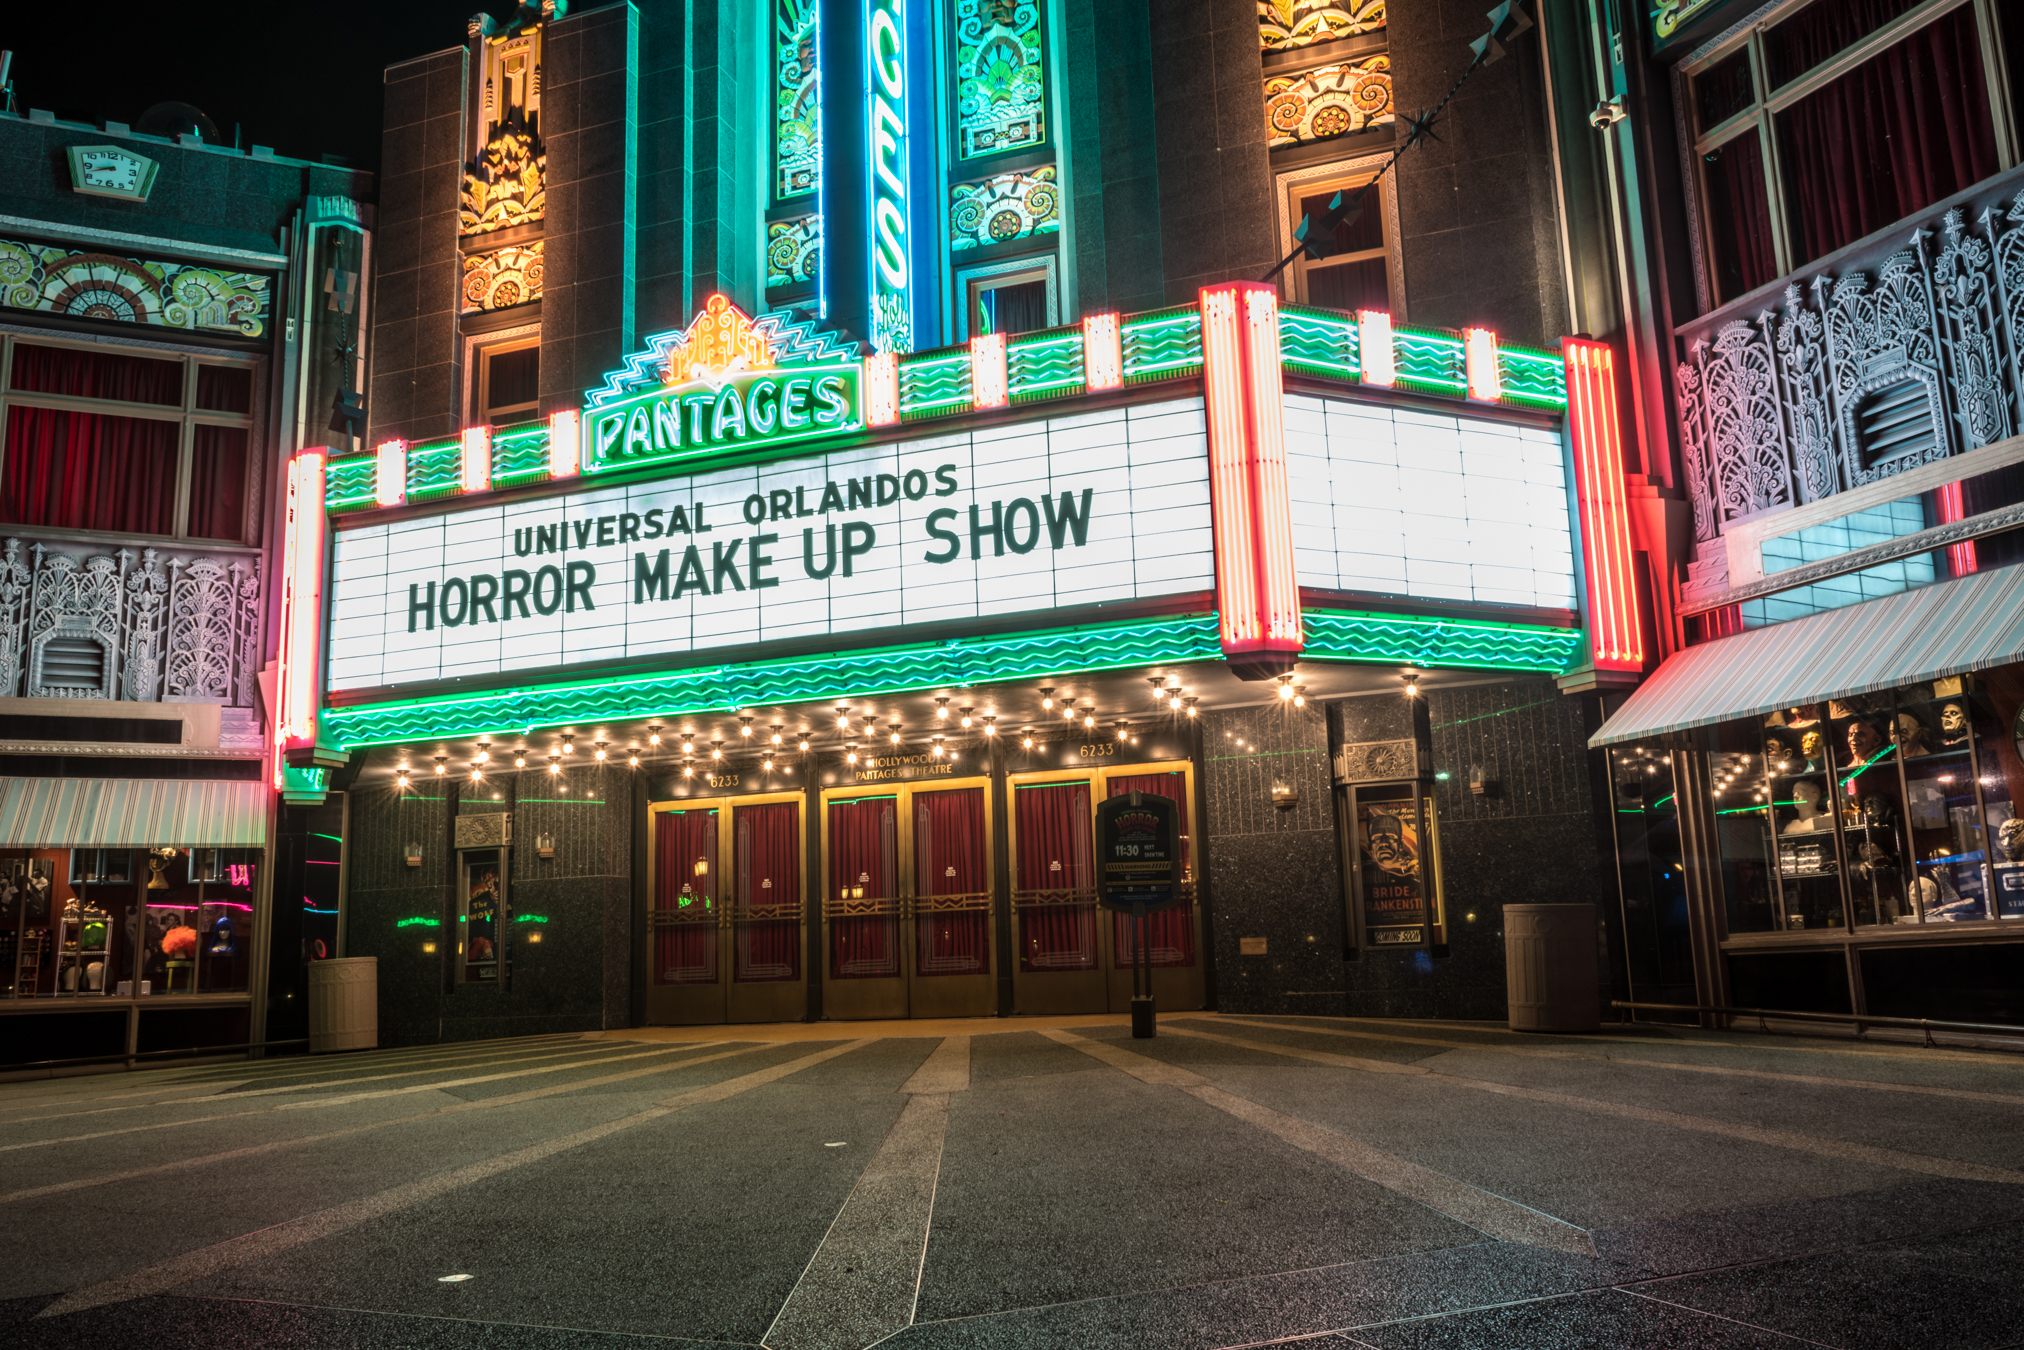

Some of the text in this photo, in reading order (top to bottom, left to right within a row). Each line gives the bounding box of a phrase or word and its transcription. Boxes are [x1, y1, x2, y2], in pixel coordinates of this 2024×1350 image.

[107, 152, 118, 160] 12
[595, 376, 848, 462] PANTAGES
[514, 464, 958, 557] UNIVERSAL ORLANDOS
[408, 488, 1093, 633] HORROR MAKE UP SHOW
[1080, 743, 1114, 758] 6233
[871, 754, 935, 768] HOLLYWOOD
[855, 763, 953, 780] PANTAGES THEATRE
[710, 774, 739, 788] 6233
[1114, 812, 1160, 830] HORROR
[1115, 844, 1139, 857] 11:30
[1373, 886, 1410, 898] BRIDE
[472, 901, 488, 909] The
[469, 908, 495, 921] WOLF
[1375, 930, 1420, 942] COMING SOON
